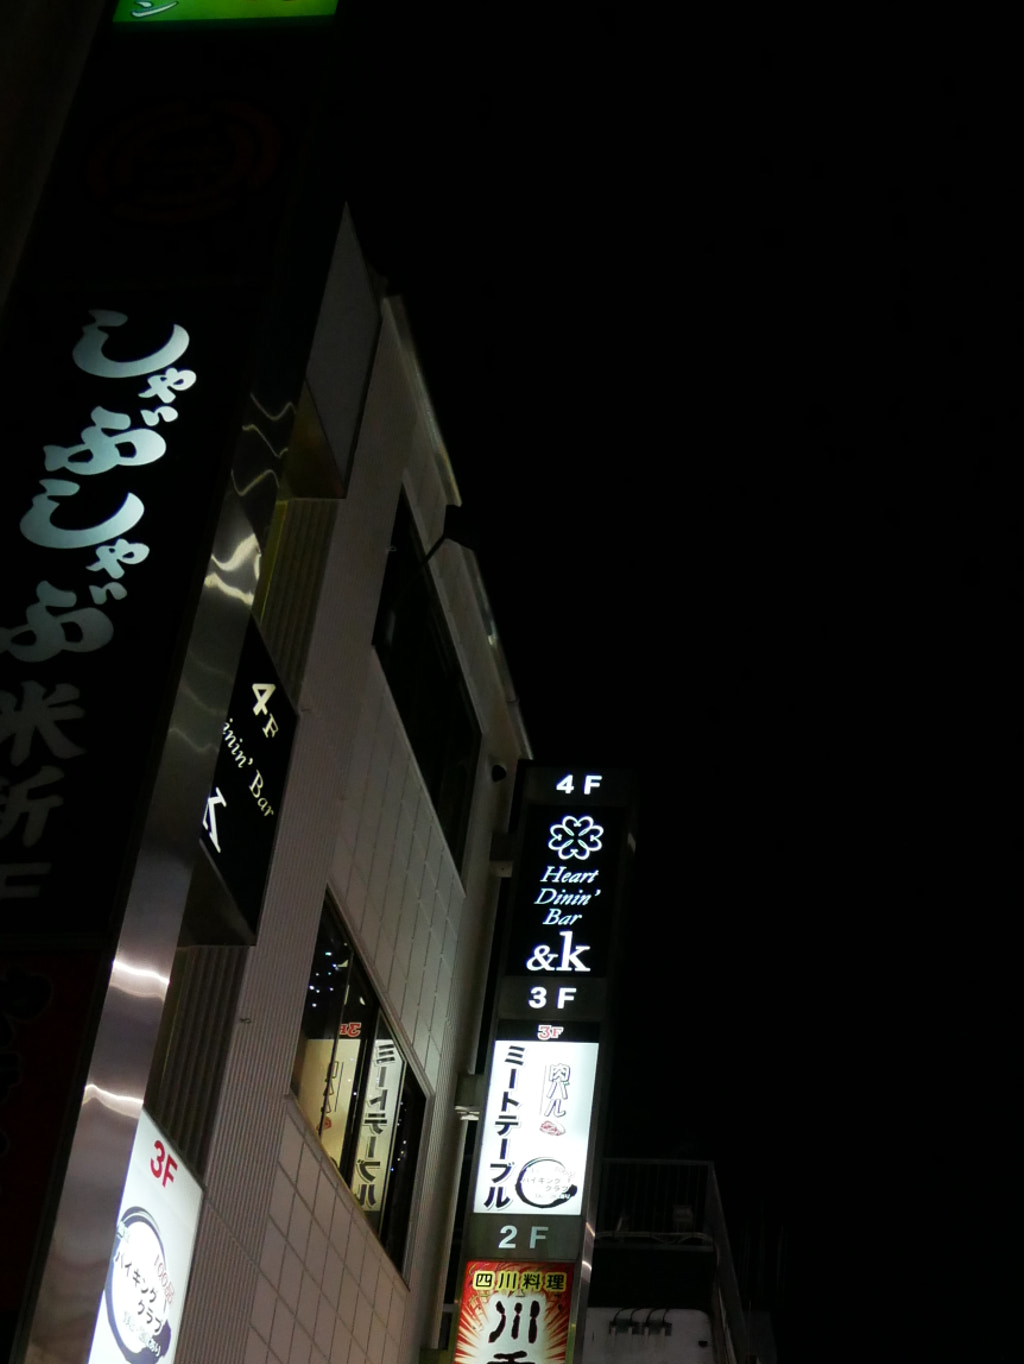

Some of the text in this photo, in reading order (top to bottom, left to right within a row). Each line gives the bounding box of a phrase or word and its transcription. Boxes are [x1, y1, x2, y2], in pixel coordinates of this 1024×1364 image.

[540, 865, 600, 884] Heart
[542, 908, 582, 926] Bar
[526, 931, 591, 973] &k
[537, 1024, 564, 1041] 3F
[483, 1045, 526, 1211] ミートテーブル
[150, 1139, 179, 1188] 3F
[474, 1271, 568, 1292] 四川料理
